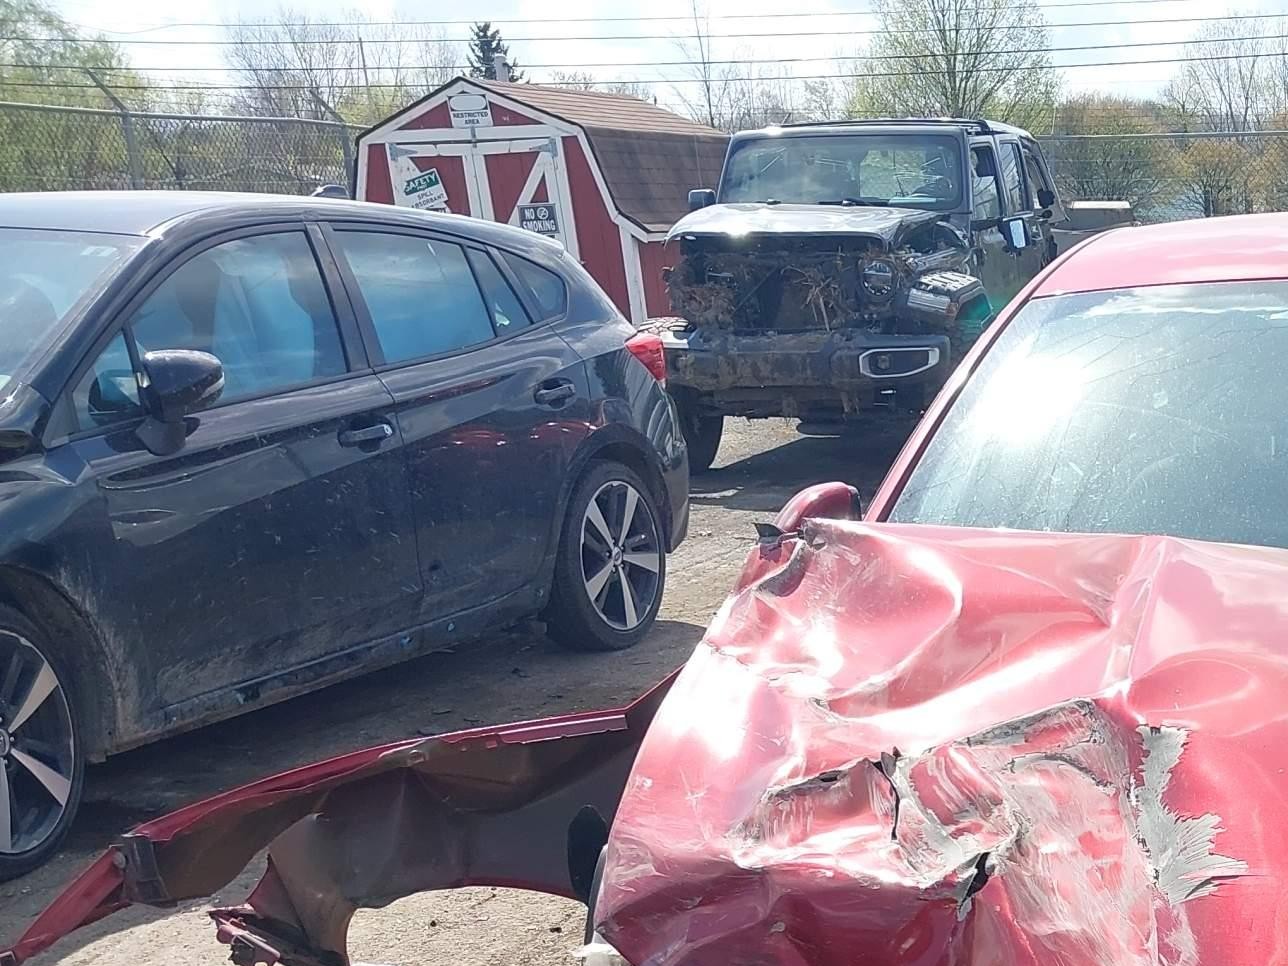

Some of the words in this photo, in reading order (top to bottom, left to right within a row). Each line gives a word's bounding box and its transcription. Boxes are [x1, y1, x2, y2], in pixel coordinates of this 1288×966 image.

[453, 111, 489, 119] RESTRICTED
[405, 173, 437, 193] SAFETY
[525, 208, 535, 219] NO
[522, 219, 556, 232] SMOKING
